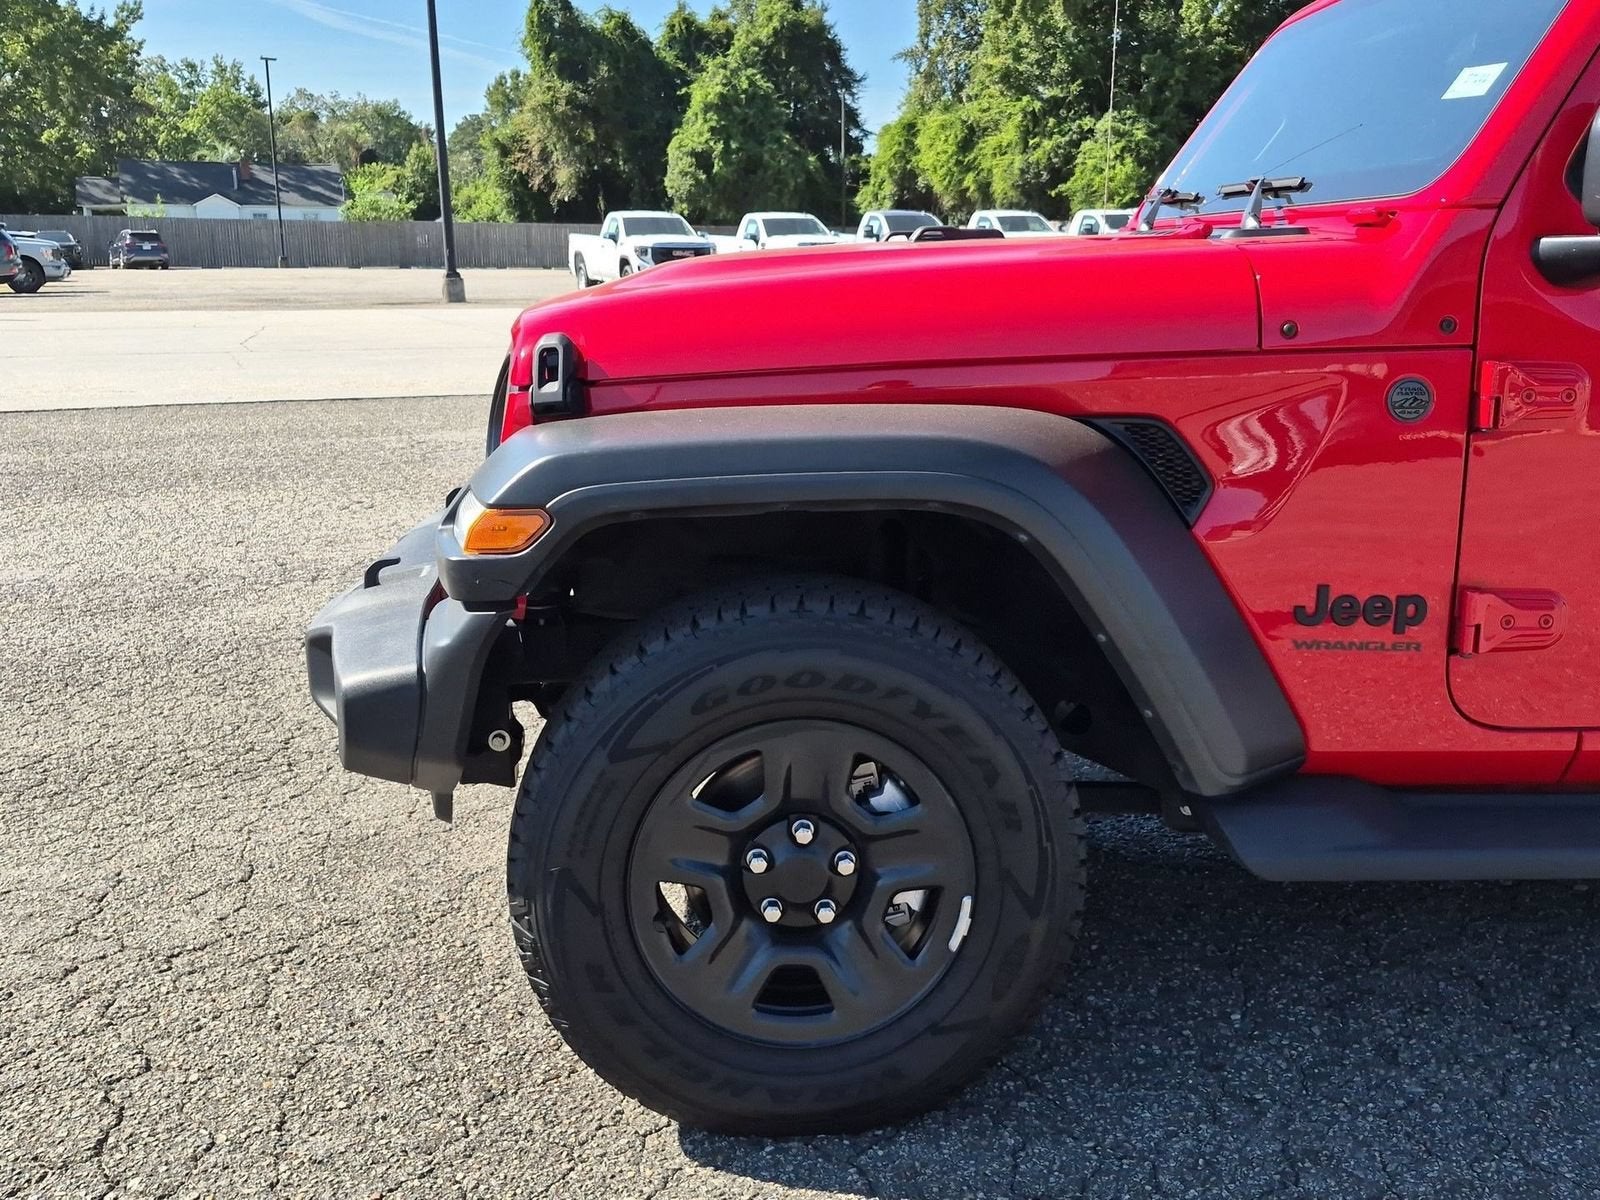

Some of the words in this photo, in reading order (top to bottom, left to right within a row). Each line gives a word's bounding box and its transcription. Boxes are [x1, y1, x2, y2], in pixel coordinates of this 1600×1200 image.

[1293, 584, 1427, 635] Jeep
[1292, 640, 1422, 652] WRANGLER
[690, 669, 1022, 833] GOODYEAR
